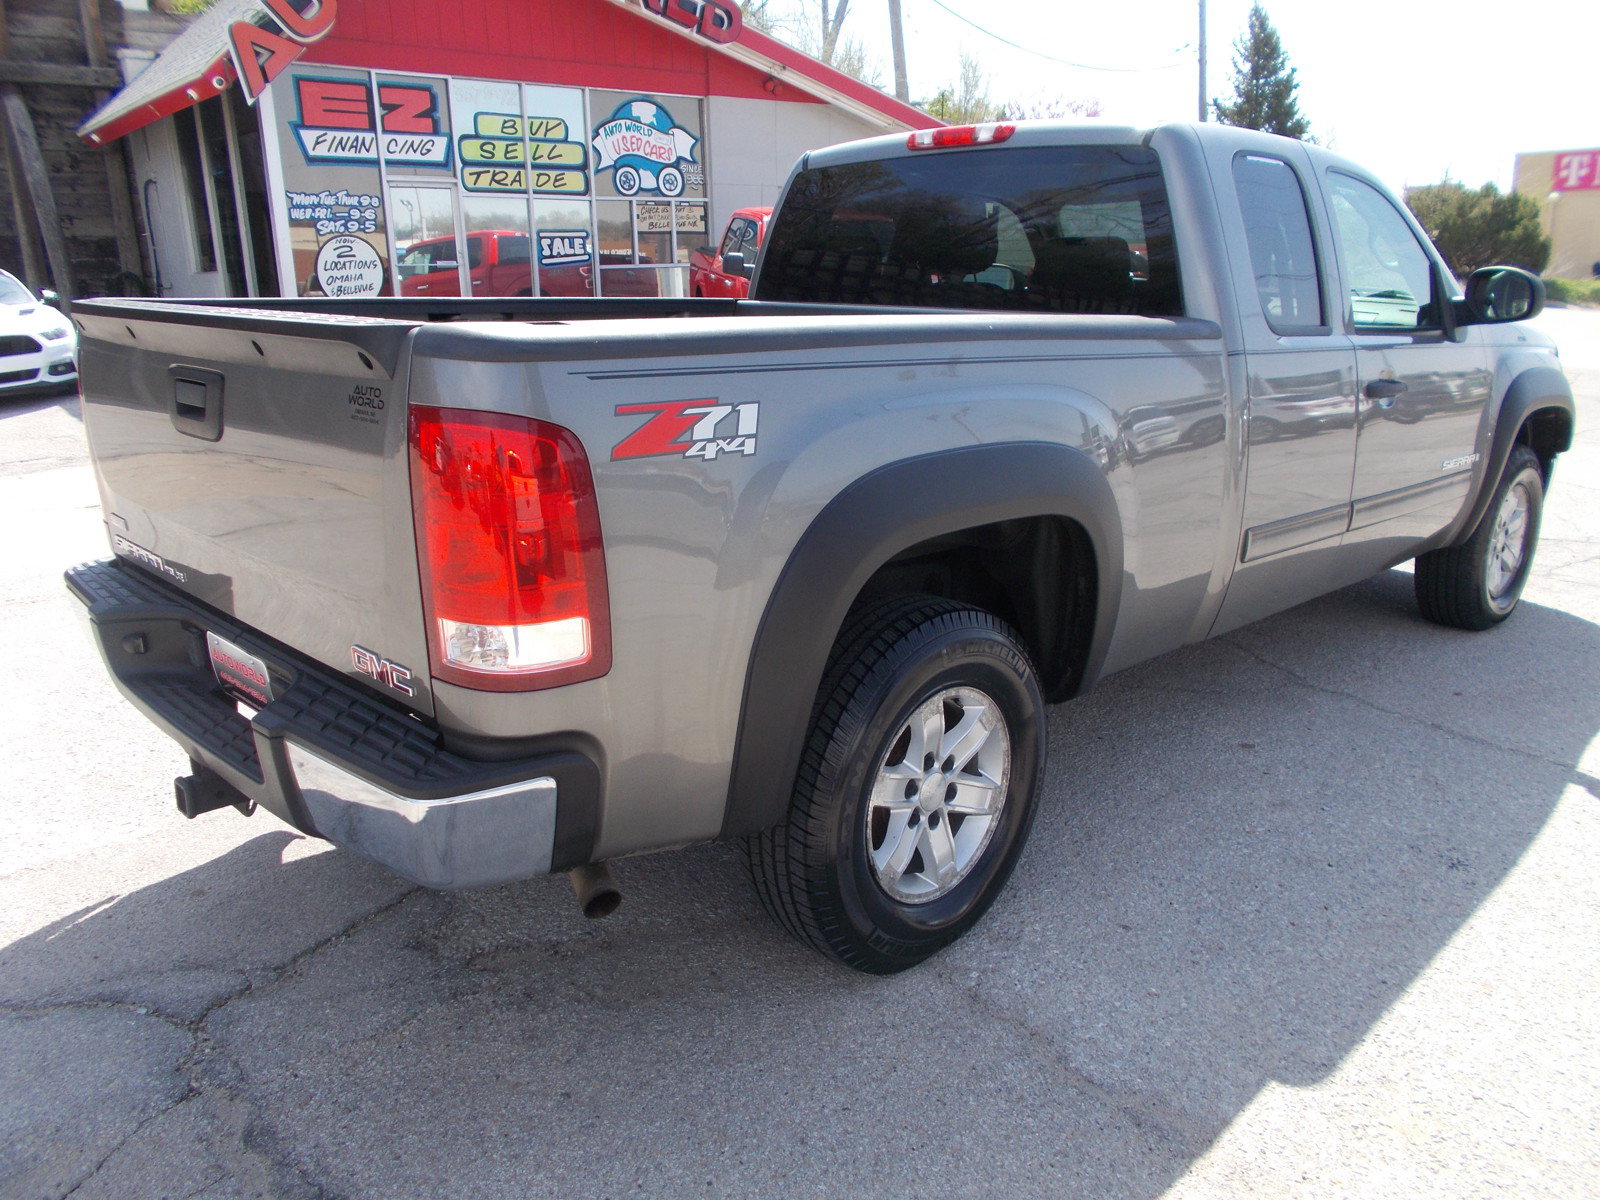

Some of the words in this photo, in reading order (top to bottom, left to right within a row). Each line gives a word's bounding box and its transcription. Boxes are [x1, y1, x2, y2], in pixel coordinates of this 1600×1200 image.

[298, 79, 434, 134] EZ
[500, 118, 562, 137] BUY
[603, 121, 623, 139] AUTO
[624, 120, 653, 137] WORLD
[480, 141, 563, 160] SELL
[612, 135, 643, 156] USED
[643, 140, 673, 161] CARS
[469, 169, 567, 188] TRADE
[333, 245, 357, 258] 2
[540, 237, 585, 256] SALE
[324, 259, 378, 272] LOCATIONS
[326, 273, 364, 286] OMAHA
[336, 283, 375, 297] BELLEVUE
[353, 384, 382, 398] AUTO
[348, 394, 385, 410] WORLD
[610, 397, 760, 462] Z71
[351, 645, 417, 697] GMC
